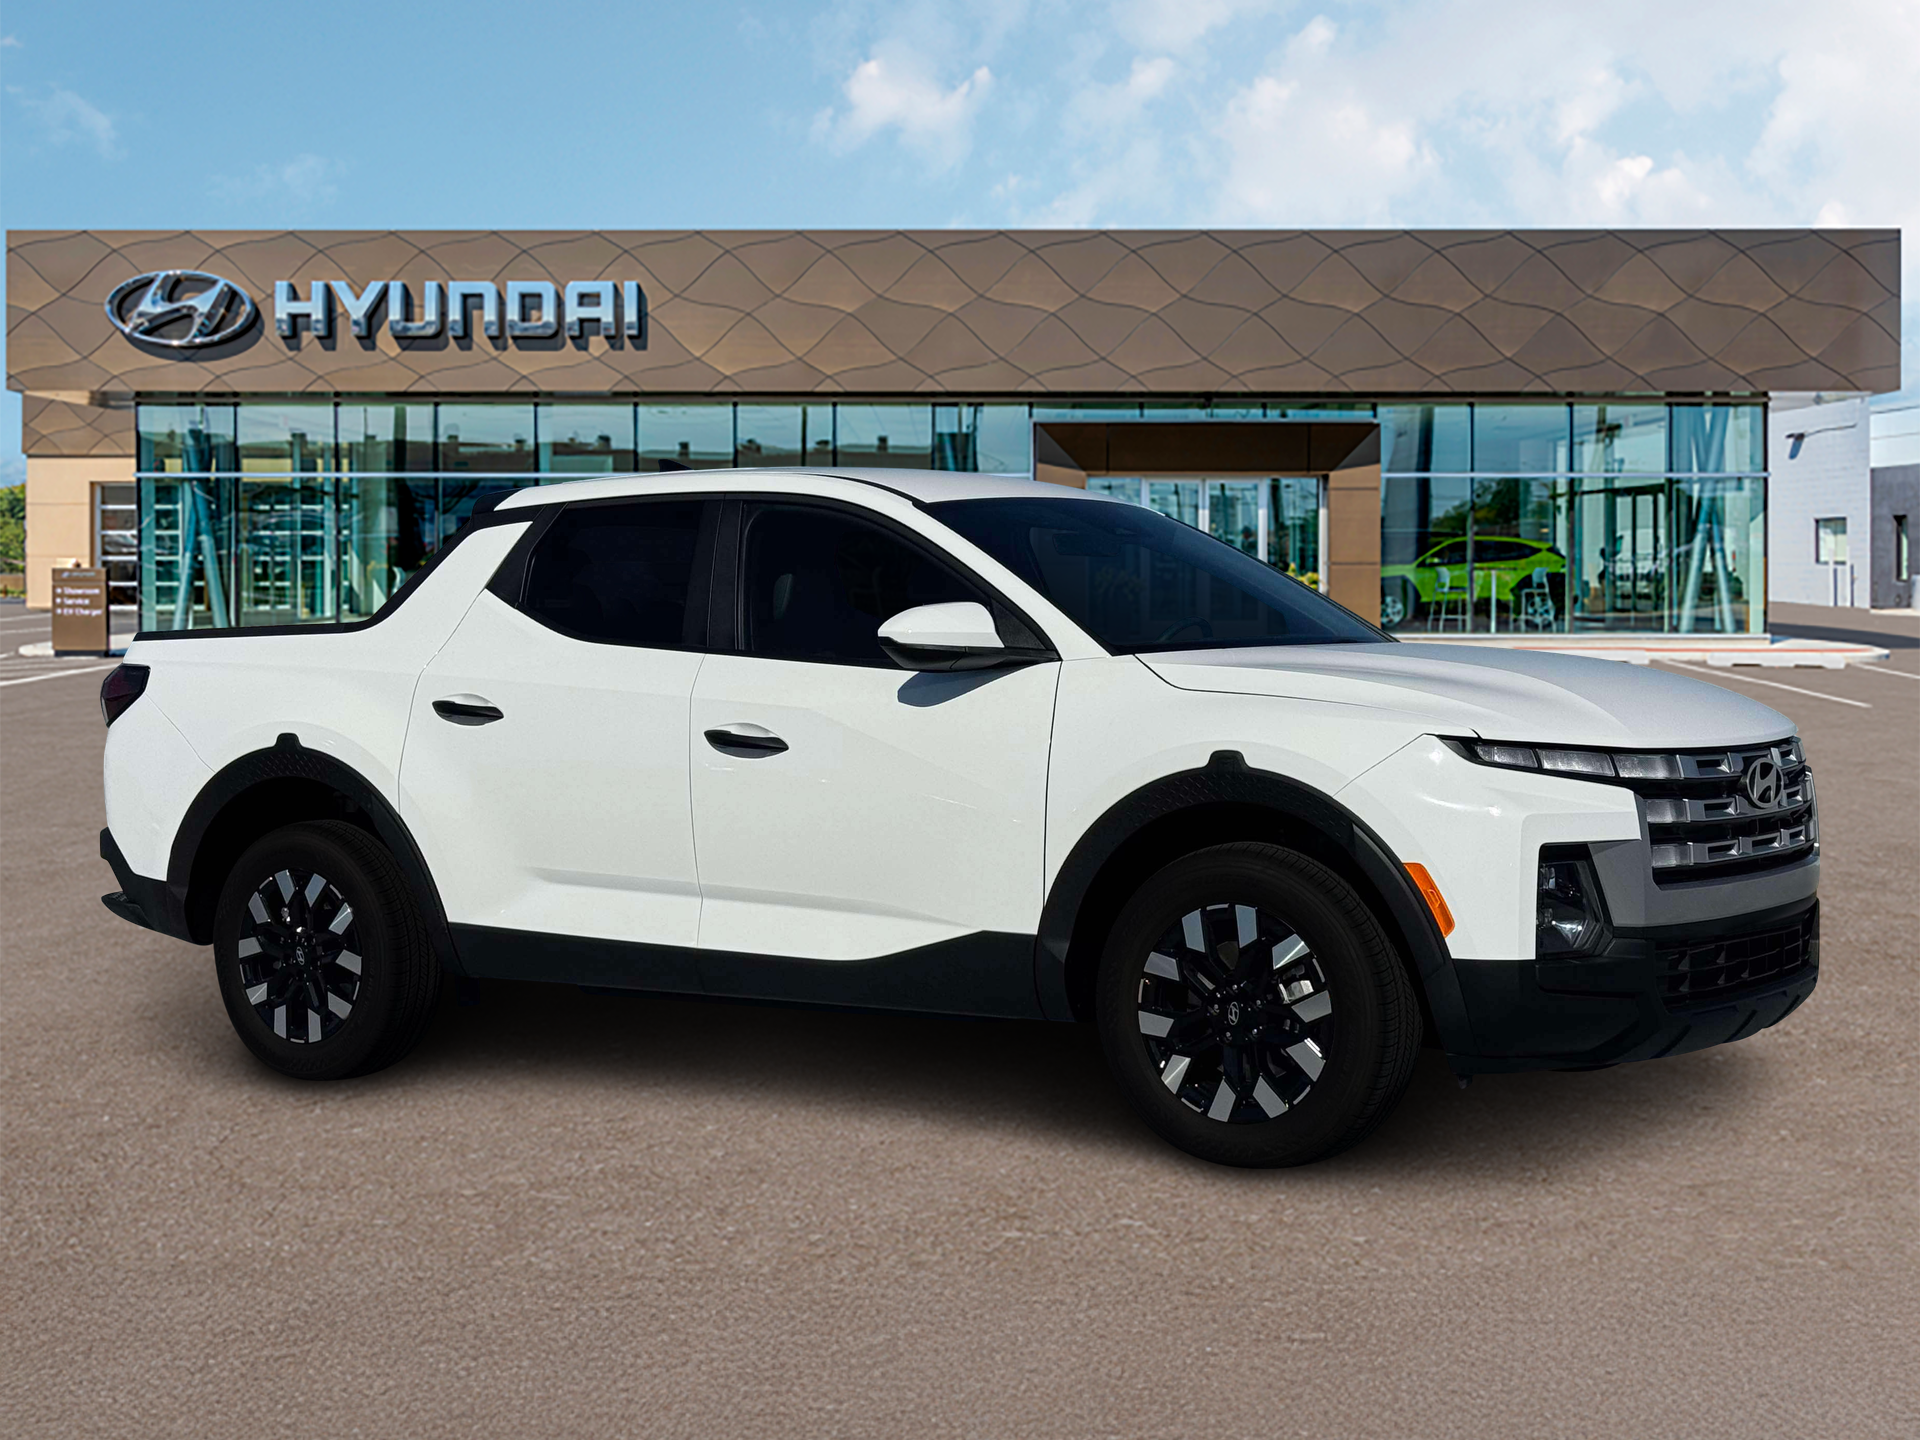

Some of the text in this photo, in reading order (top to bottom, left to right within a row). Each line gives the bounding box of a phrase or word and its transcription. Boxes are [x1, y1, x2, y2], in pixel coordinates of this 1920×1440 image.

[274, 280, 639, 337] HYUNDAI
[63, 587, 100, 595] Showroom
[75, 608, 103, 617] Charger
